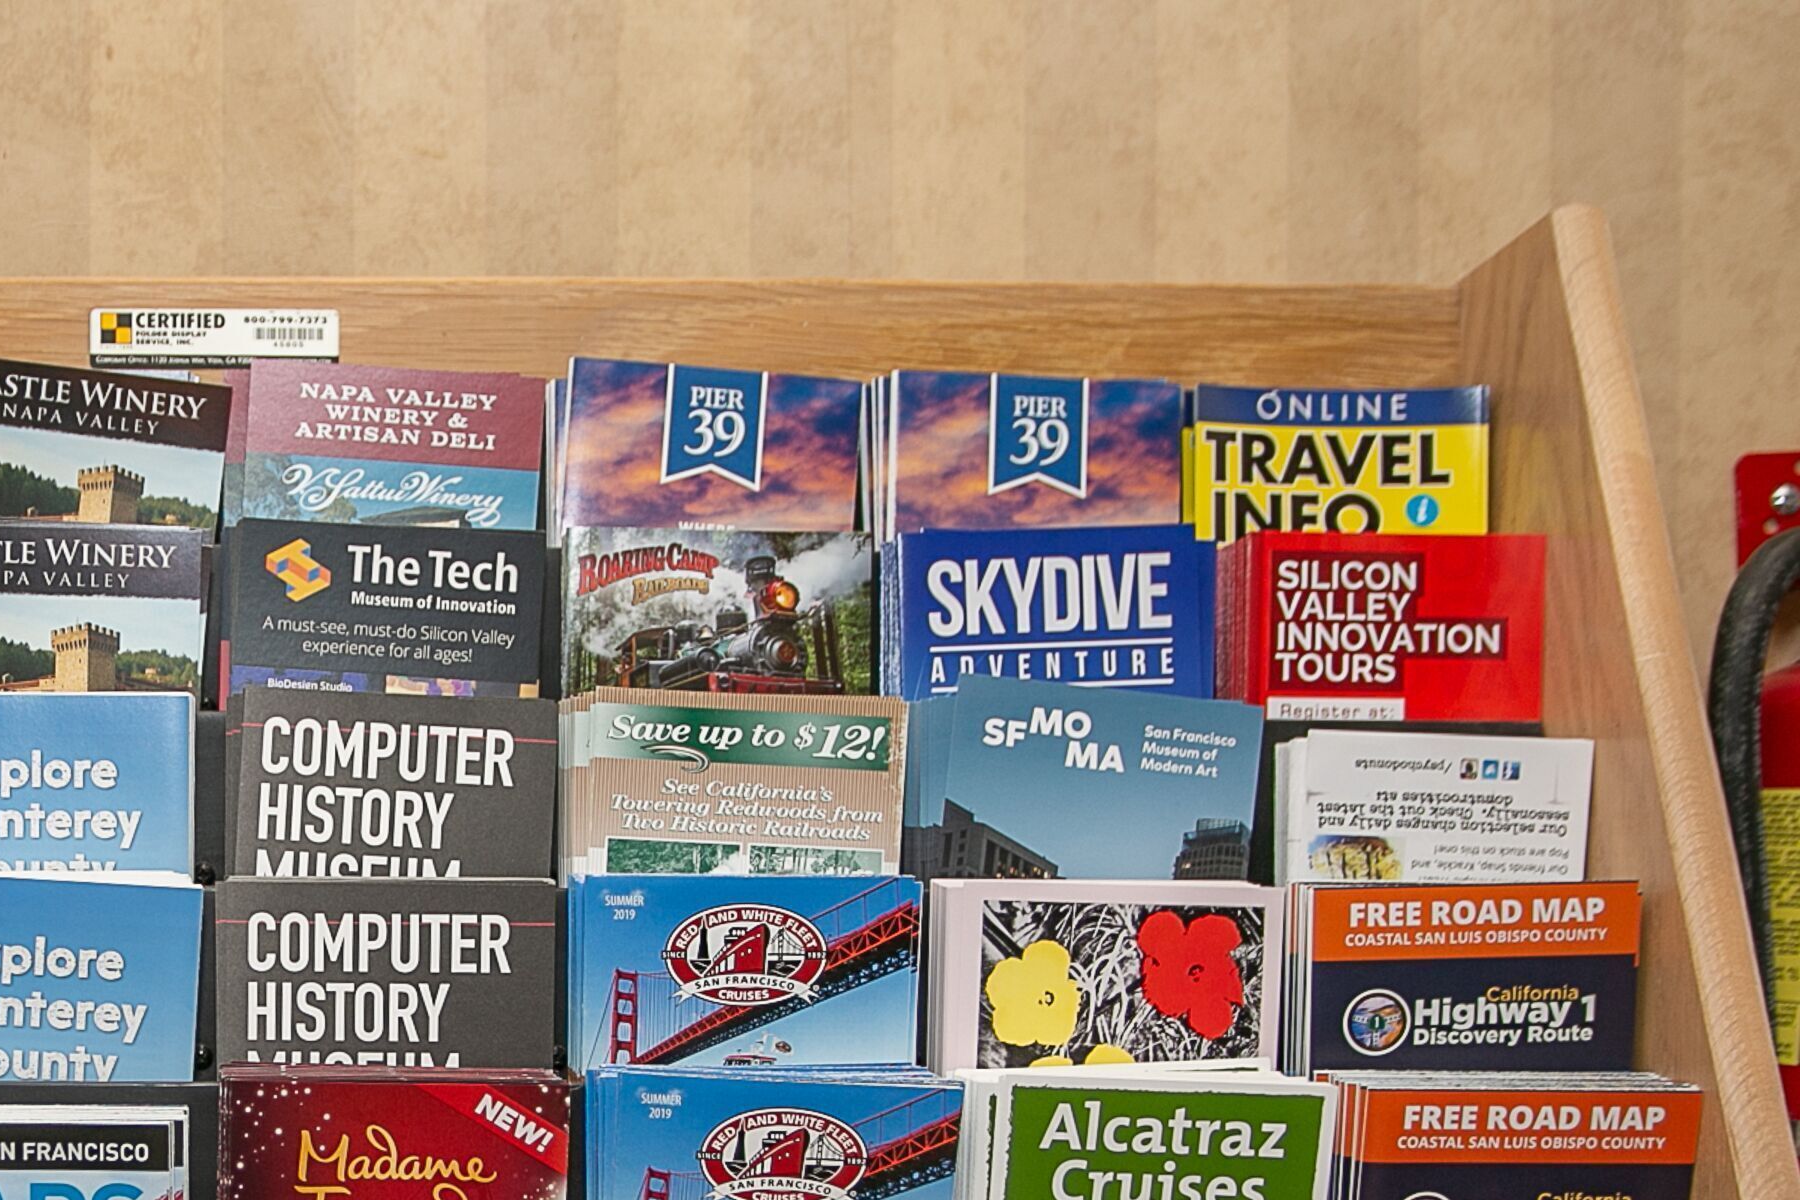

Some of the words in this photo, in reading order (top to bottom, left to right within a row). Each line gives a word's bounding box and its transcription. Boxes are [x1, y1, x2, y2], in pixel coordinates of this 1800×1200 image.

[136, 313, 225, 328] CERTIFIED
[244, 316, 328, 324] 800-799-7373
[300, 382, 377, 405] NAPA
[386, 387, 497, 411] VALLEY
[690, 385, 744, 409] PIER
[1257, 389, 1408, 422] ONLINE
[326, 404, 437, 428] WINERY
[447, 409, 468, 428] &
[296, 422, 421, 446] ARTISAN
[431, 431, 497, 450] DELI
[683, 408, 745, 458] 39
[1205, 432, 1451, 484] TRAVEL
[348, 544, 421, 587] The
[428, 550, 518, 594] Tech
[1277, 560, 1417, 591] SILICON
[351, 591, 411, 609] Museum
[417, 594, 433, 610] of
[437, 595, 515, 614] Innovation
[927, 551, 1172, 640] SKYDIVE
[1277, 592, 1409, 623] VALLEY
[277, 617, 349, 636] must-see,
[354, 621, 415, 640] must-do
[421, 625, 467, 643] Silicon
[471, 629, 515, 648] Valley
[1276, 623, 1501, 653] INNOVATION
[1276, 654, 1397, 683] TOURS
[607, 714, 690, 742] Save
[698, 724, 742, 749] up
[751, 727, 784, 748] to
[793, 722, 887, 761] $12!
[1144, 725, 1172, 740] San
[1174, 729, 1236, 747] Francisco
[262, 716, 515, 787] COMPUTER
[1142, 742, 1198, 760] Museum
[1203, 748, 1218, 761] of
[1141, 759, 1191, 776] Modern
[1195, 763, 1218, 777] Art
[662, 779, 702, 795] See
[706, 780, 832, 802] California's
[258, 784, 454, 849] HISTORY
[611, 794, 711, 816] Towering
[717, 800, 827, 821] Redwoods
[830, 804, 882, 824] from
[622, 814, 665, 831] Two
[669, 818, 757, 835] Historic
[765, 821, 870, 841] Railroads
[1350, 902, 1421, 927] FREE
[1431, 900, 1521, 924] ROAD
[1532, 897, 1605, 923] MAP
[1345, 931, 1412, 947] COASTAL
[1415, 930, 1446, 945] SAN
[1449, 930, 1483, 944] LUIS
[1487, 930, 1541, 944] OBISPO
[1544, 928, 1608, 941] COUNTY
[1487, 986, 1579, 1001] California
[1414, 997, 1569, 1030] Highway
[1413, 1027, 1522, 1048] Discovery
[1528, 1026, 1593, 1042] Route
[474, 1093, 554, 1154] NEW!
[1040, 1101, 1288, 1159] Alcatraz
[22, 1141, 149, 1163] FRANCISCO
[297, 1125, 496, 1183] Madame
